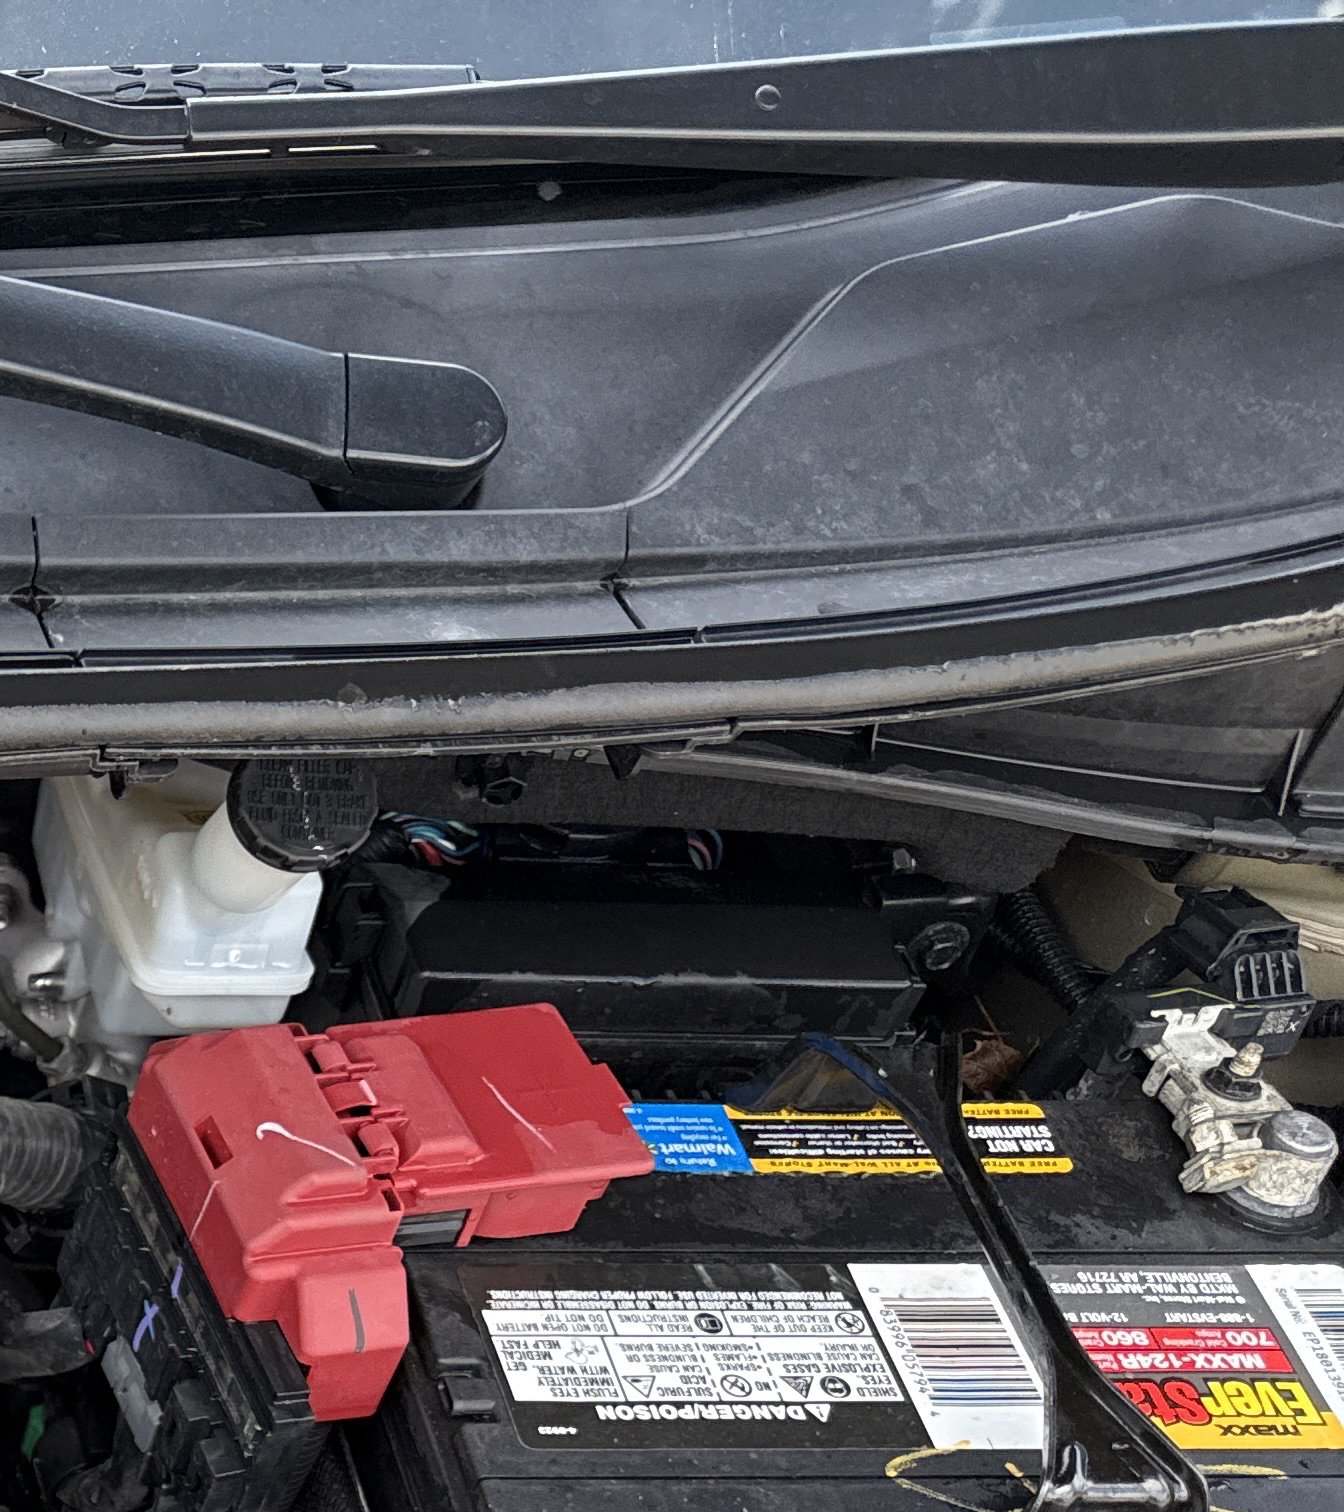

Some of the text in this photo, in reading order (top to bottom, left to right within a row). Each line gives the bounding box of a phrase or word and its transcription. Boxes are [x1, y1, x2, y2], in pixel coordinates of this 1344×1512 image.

[967, 1125, 1052, 1138] STARTING?
[659, 1143, 736, 1155] Walmart
[986, 1139, 1055, 1152] CAR NOT
[665, 1157, 716, 1167] Return to
[1121, 1272, 1138, 1282] AR
[1138, 1271, 1234, 1283] BENTONVILLE,
[1050, 1282, 1239, 1294] MKTD BY WAL-MART STORES
[564, 1314, 585, 1323] NOT
[588, 1314, 604, 1323] DO
[730, 1314, 830, 1323] REACH OF CHILDREN
[1080, 1312, 1129, 1322] 12-VOLT
[540, 1323, 608, 1332] DO NOT OPEN
[646, 1324, 693, 1332] READ ALL
[751, 1324, 834, 1332] KEEP OUT OF THE
[1101, 1331, 1149, 1346] 860
[1225, 1331, 1275, 1346] 700
[496, 1339, 562, 1349] HELP FAST.
[615, 1343, 694, 1351] SEVERE BURNS.
[820, 1343, 875, 1351] OR INJURY.
[500, 1350, 552, 1361] MEDICAL
[767, 1352, 879, 1361] CAN CAUSE BLINDNESS
[880, 1309, 929, 1394] 83996 05794
[625, 1354, 698, 1362] BLINDNESS OR
[1116, 1352, 1266, 1369] MAXX-124R
[505, 1361, 527, 1371] GET
[532, 1365, 610, 1375] WITH WATER.
[647, 1364, 702, 1372] CAN CAUSE
[783, 1363, 885, 1373] EXPLOSIVE GASES
[537, 1376, 615, 1386] IMMEDIATELY
[679, 1375, 707, 1384] ACID
[857, 1375, 890, 1385] EYES.
[755, 1381, 772, 1391] NO
[549, 1388, 619, 1398] FLUSH EYES
[656, 1387, 713, 1397] SULFURIC
[857, 1387, 897, 1397] SHIELD
[594, 1403, 807, 1420] DANGER/POISON
[1214, 1424, 1302, 1436] maxx
